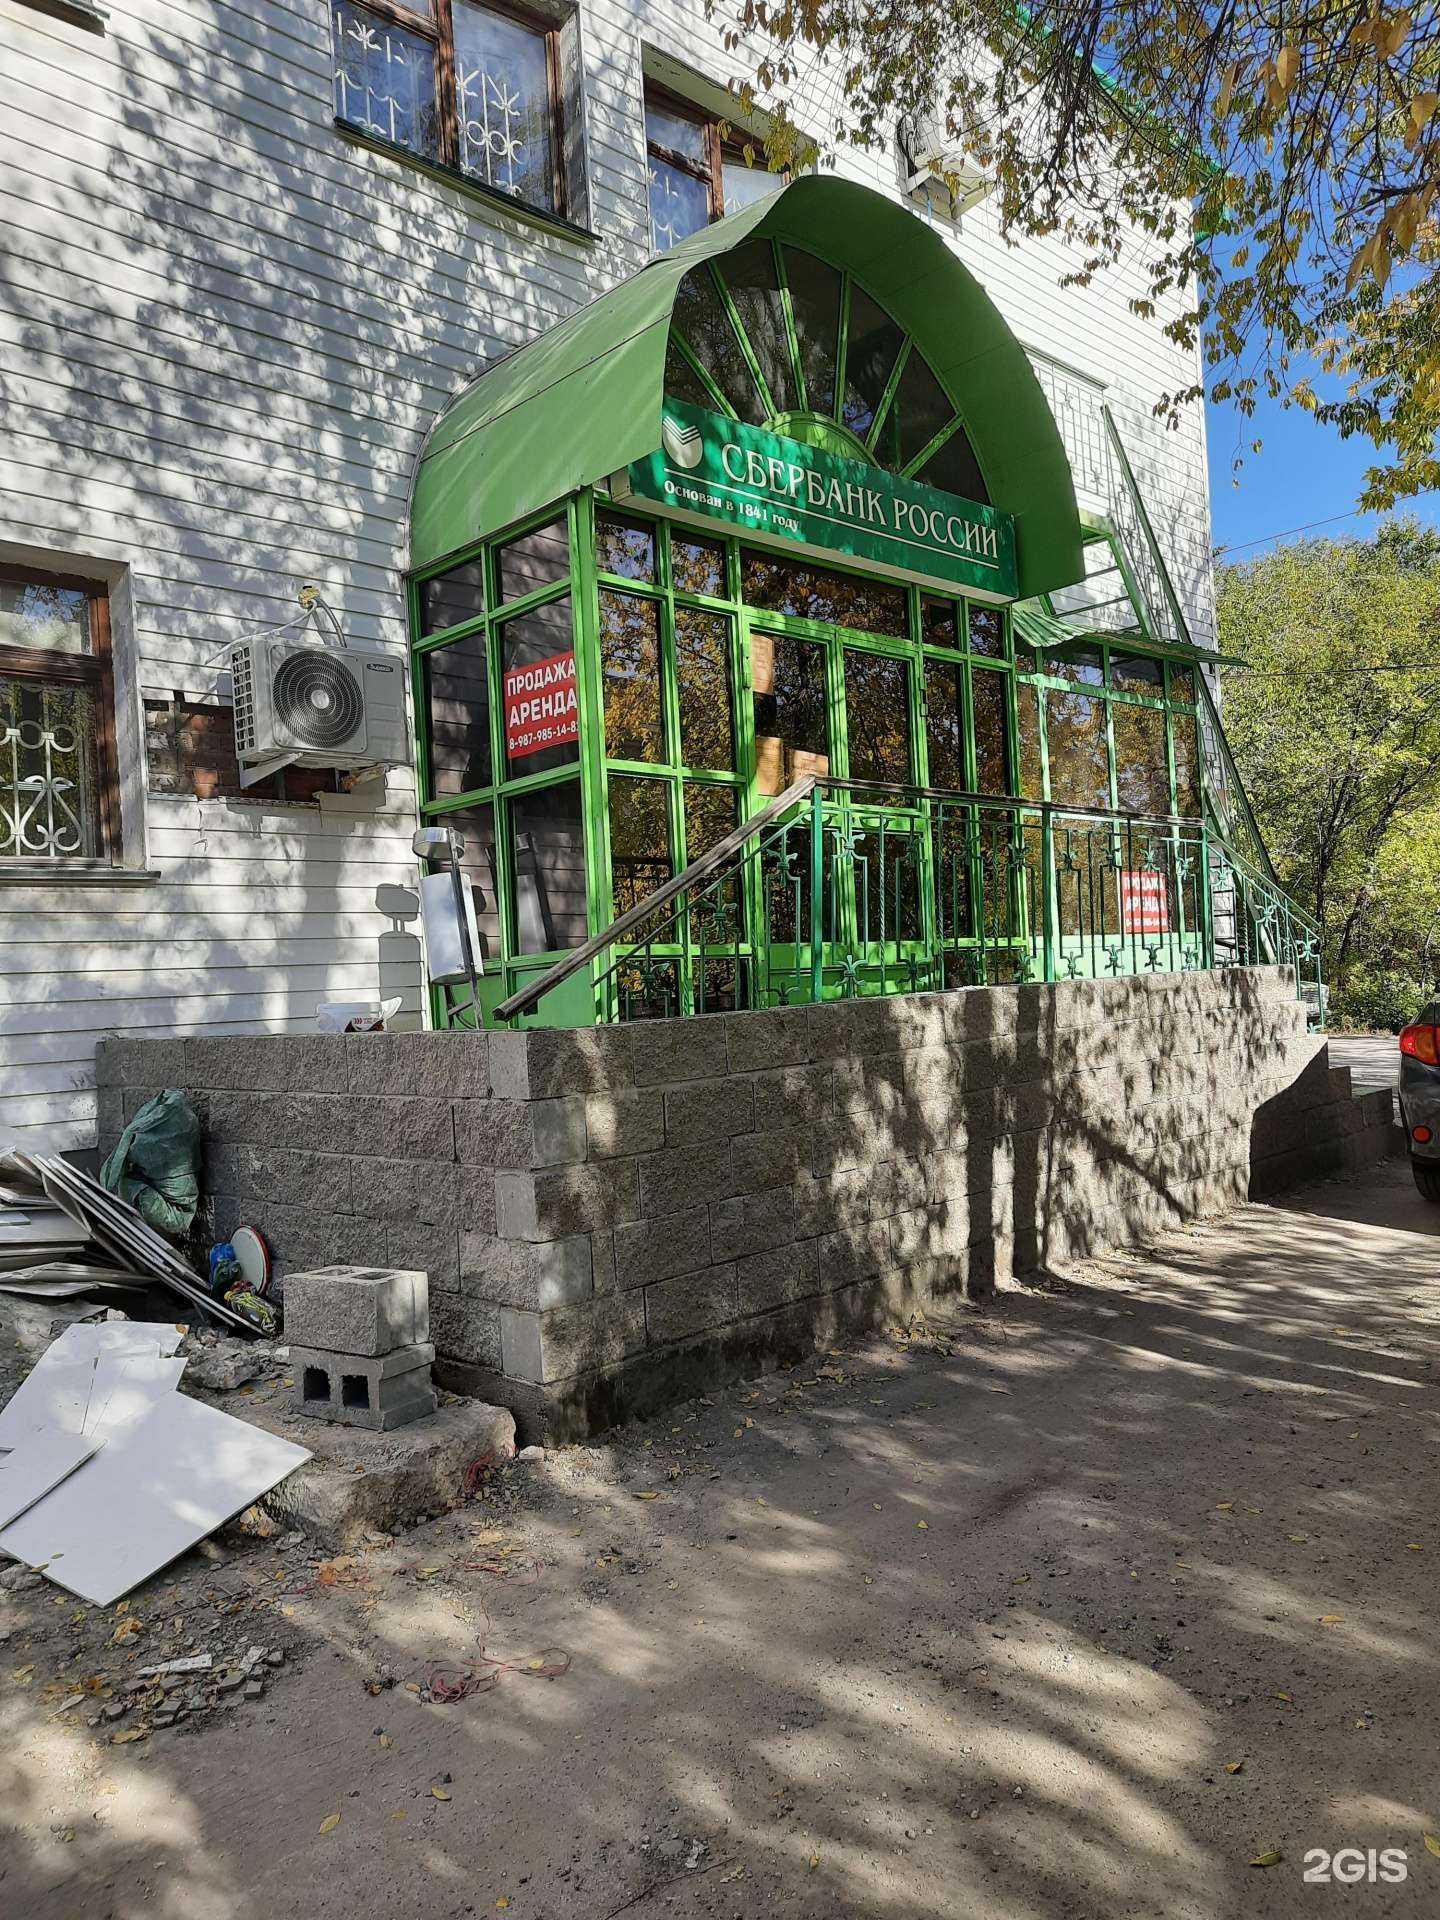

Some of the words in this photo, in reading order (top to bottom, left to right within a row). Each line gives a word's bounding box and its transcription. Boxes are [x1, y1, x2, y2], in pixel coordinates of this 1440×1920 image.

[664, 480, 722, 509] Основан
[725, 500, 735, 512] в
[738, 502, 768, 522] 1841
[772, 513, 800, 533] году
[721, 443, 888, 527] СБЕРБАНК
[893, 497, 998, 559] РОССИИ
[507, 657, 576, 697] ПРОДАЖА
[509, 687, 578, 728] АРЕНДА
